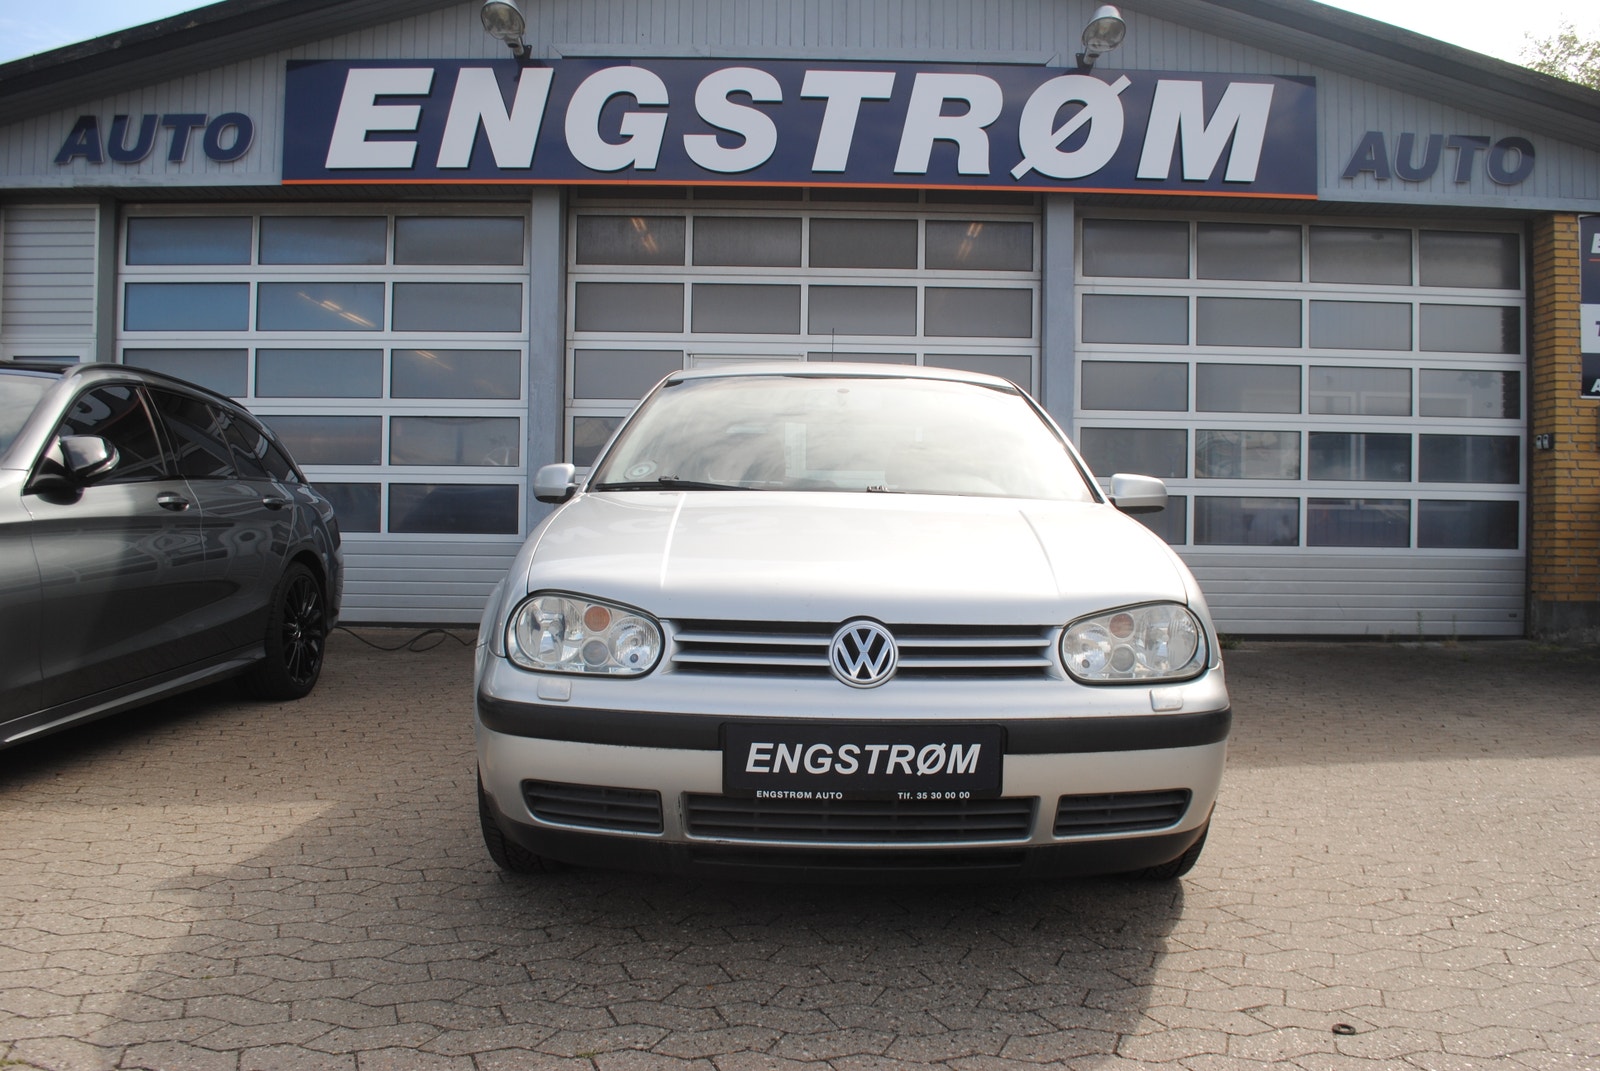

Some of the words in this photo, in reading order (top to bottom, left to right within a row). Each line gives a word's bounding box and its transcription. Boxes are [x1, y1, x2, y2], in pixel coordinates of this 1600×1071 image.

[53, 112, 255, 164] AUTO
[324, 65, 1275, 184] ENGSTRØM
[1341, 130, 1536, 186] AUTO
[745, 742, 982, 776] ENGSTRØM
[756, 790, 813, 800] ENGSTRØM
[815, 791, 844, 800] AUTO
[916, 791, 928, 800] 35
[930, 791, 942, 800] 30
[944, 791, 956, 800] 00
[958, 791, 971, 799] 00
